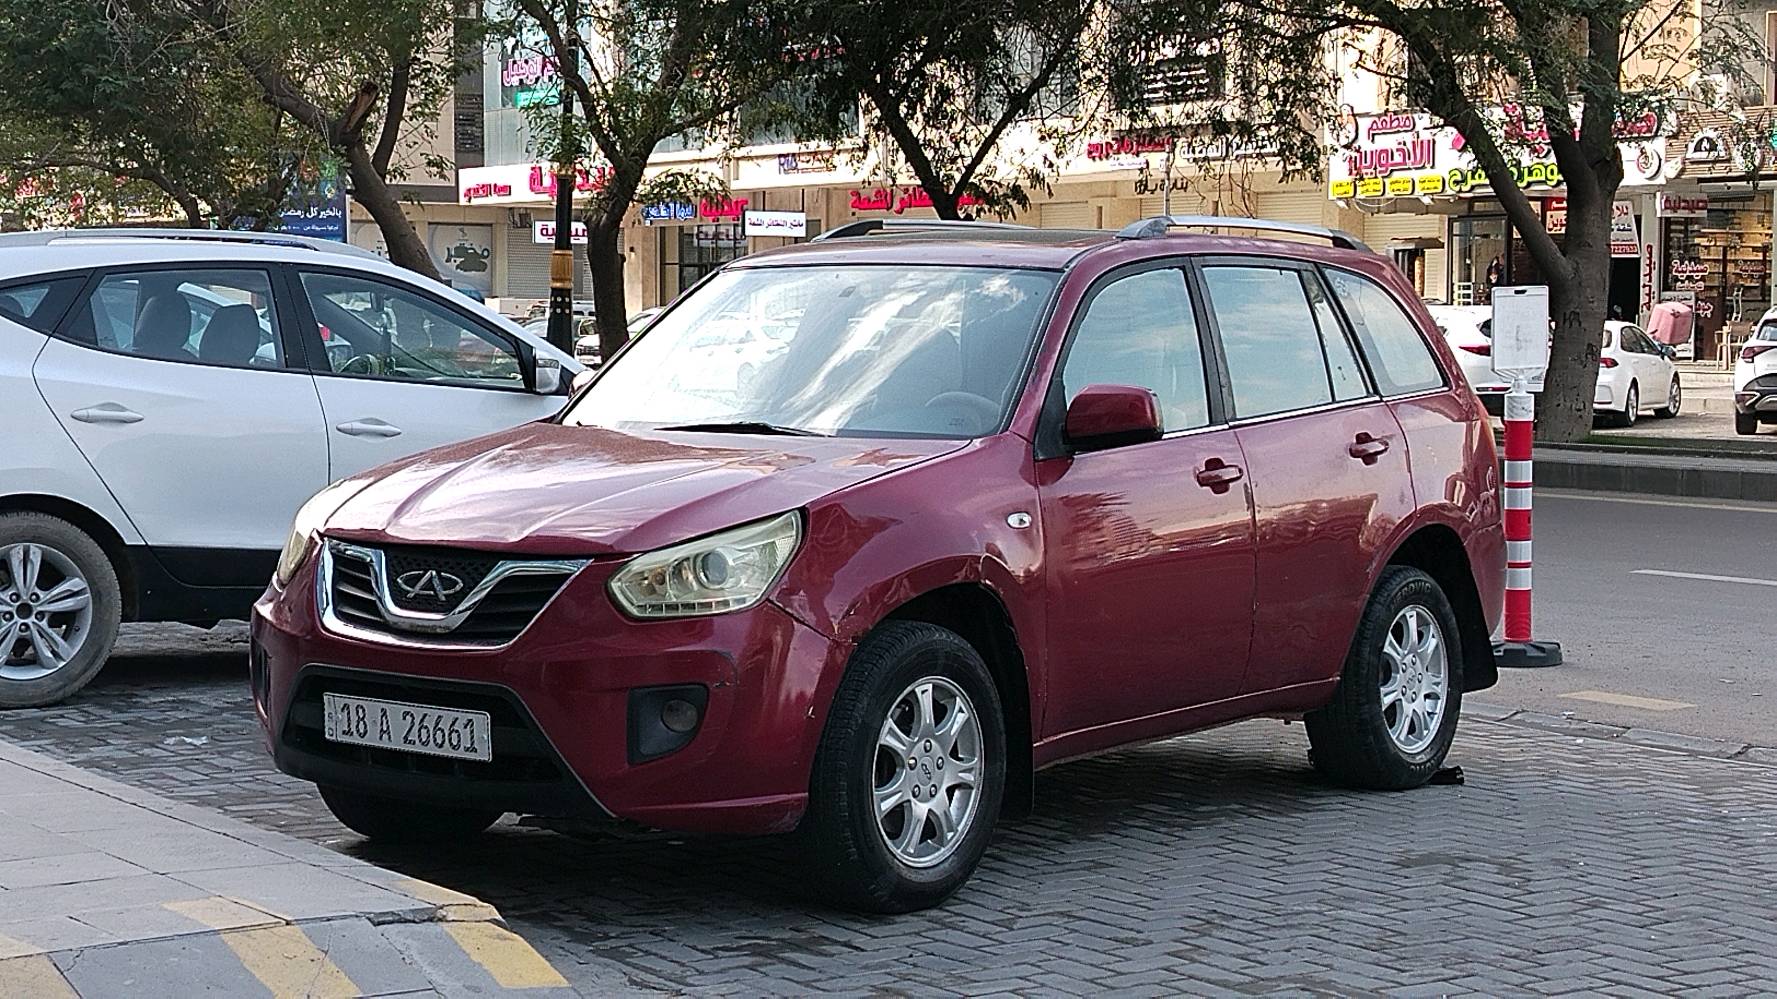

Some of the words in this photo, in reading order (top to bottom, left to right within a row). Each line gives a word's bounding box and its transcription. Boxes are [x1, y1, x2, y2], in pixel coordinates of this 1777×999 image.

[1367, 112, 1414, 141] مطعم
[1347, 134, 1433, 177] الأخوين
[306, 206, 318, 223] كل
[319, 206, 342, 223] بالخير
[1662, 195, 1707, 214] صيدلية
[1642, 243, 1657, 314] صيدلية
[1672, 260, 1708, 280] صيدلية
[340, 703, 368, 739] 18
[378, 708, 393, 743] A
[401, 710, 478, 753] 26661
